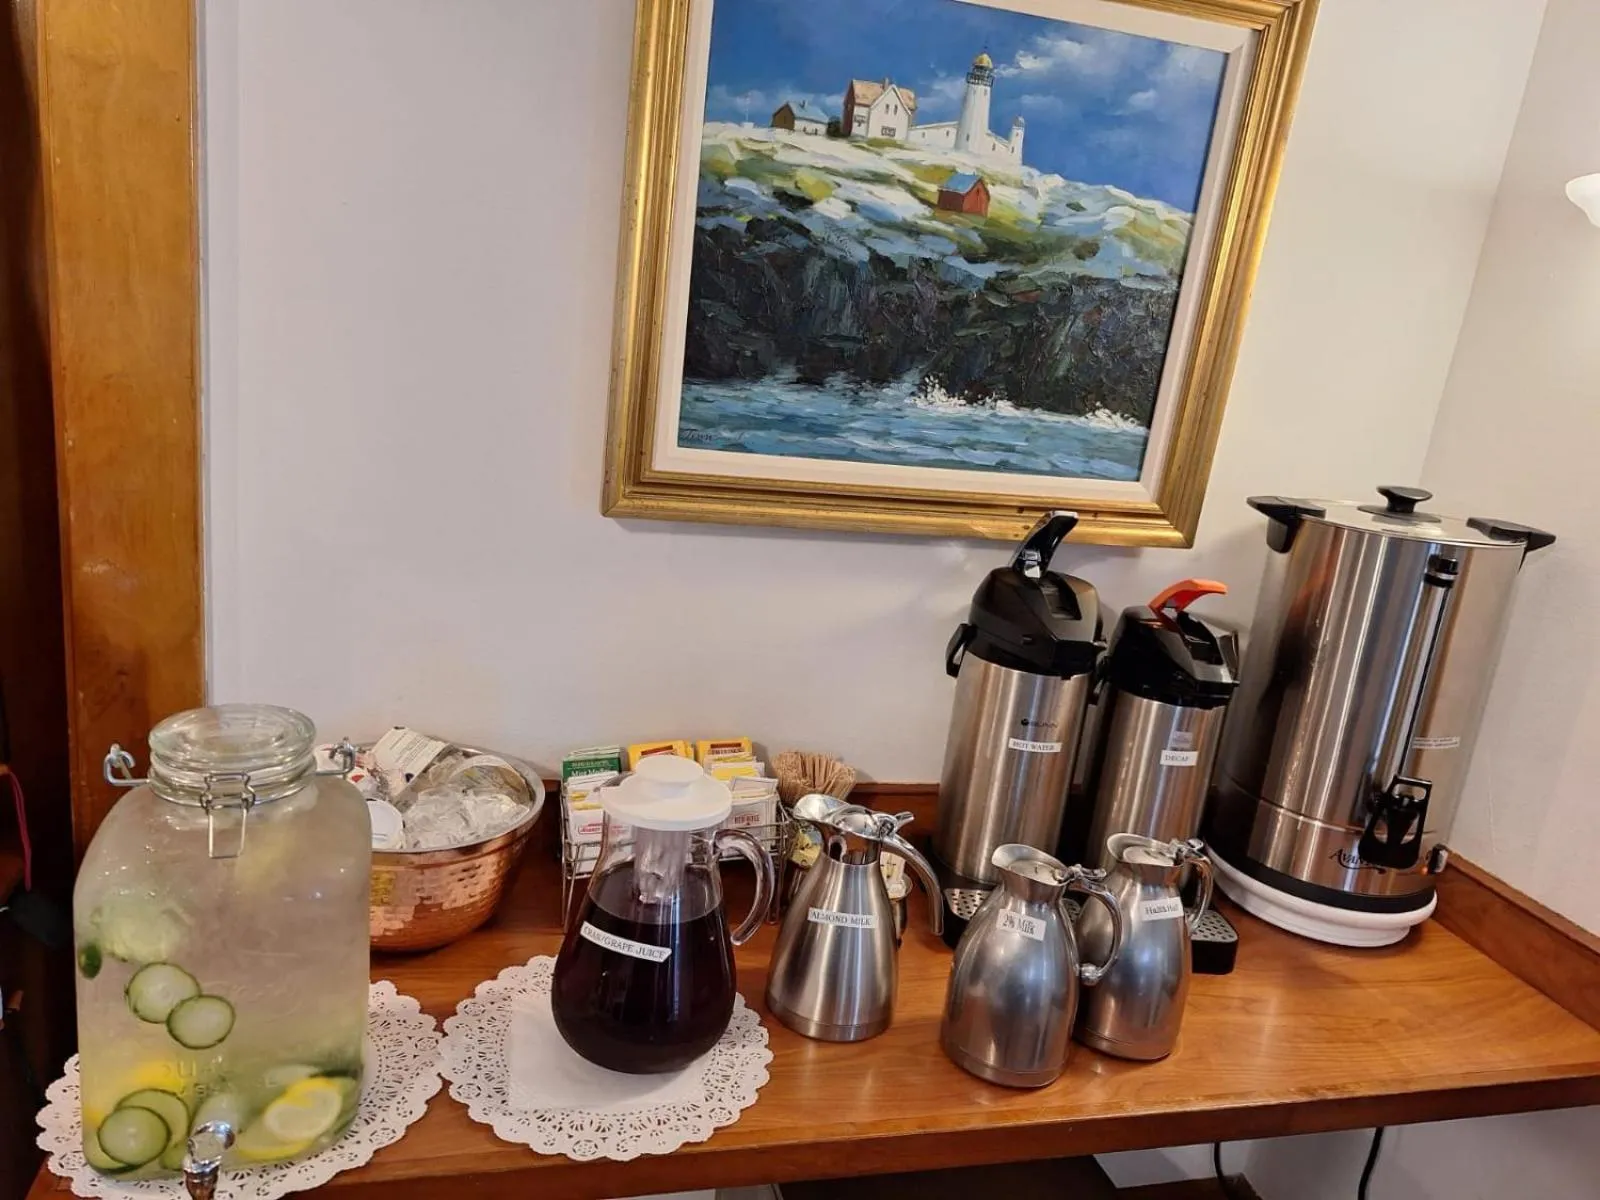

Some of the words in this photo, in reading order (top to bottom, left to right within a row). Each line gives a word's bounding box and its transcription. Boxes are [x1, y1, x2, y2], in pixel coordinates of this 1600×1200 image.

[1012, 740, 1028, 749] HOT
[811, 911, 848, 923] ALMOND
[850, 916, 872, 925] MILK
[635, 946, 667, 959] JUICE
